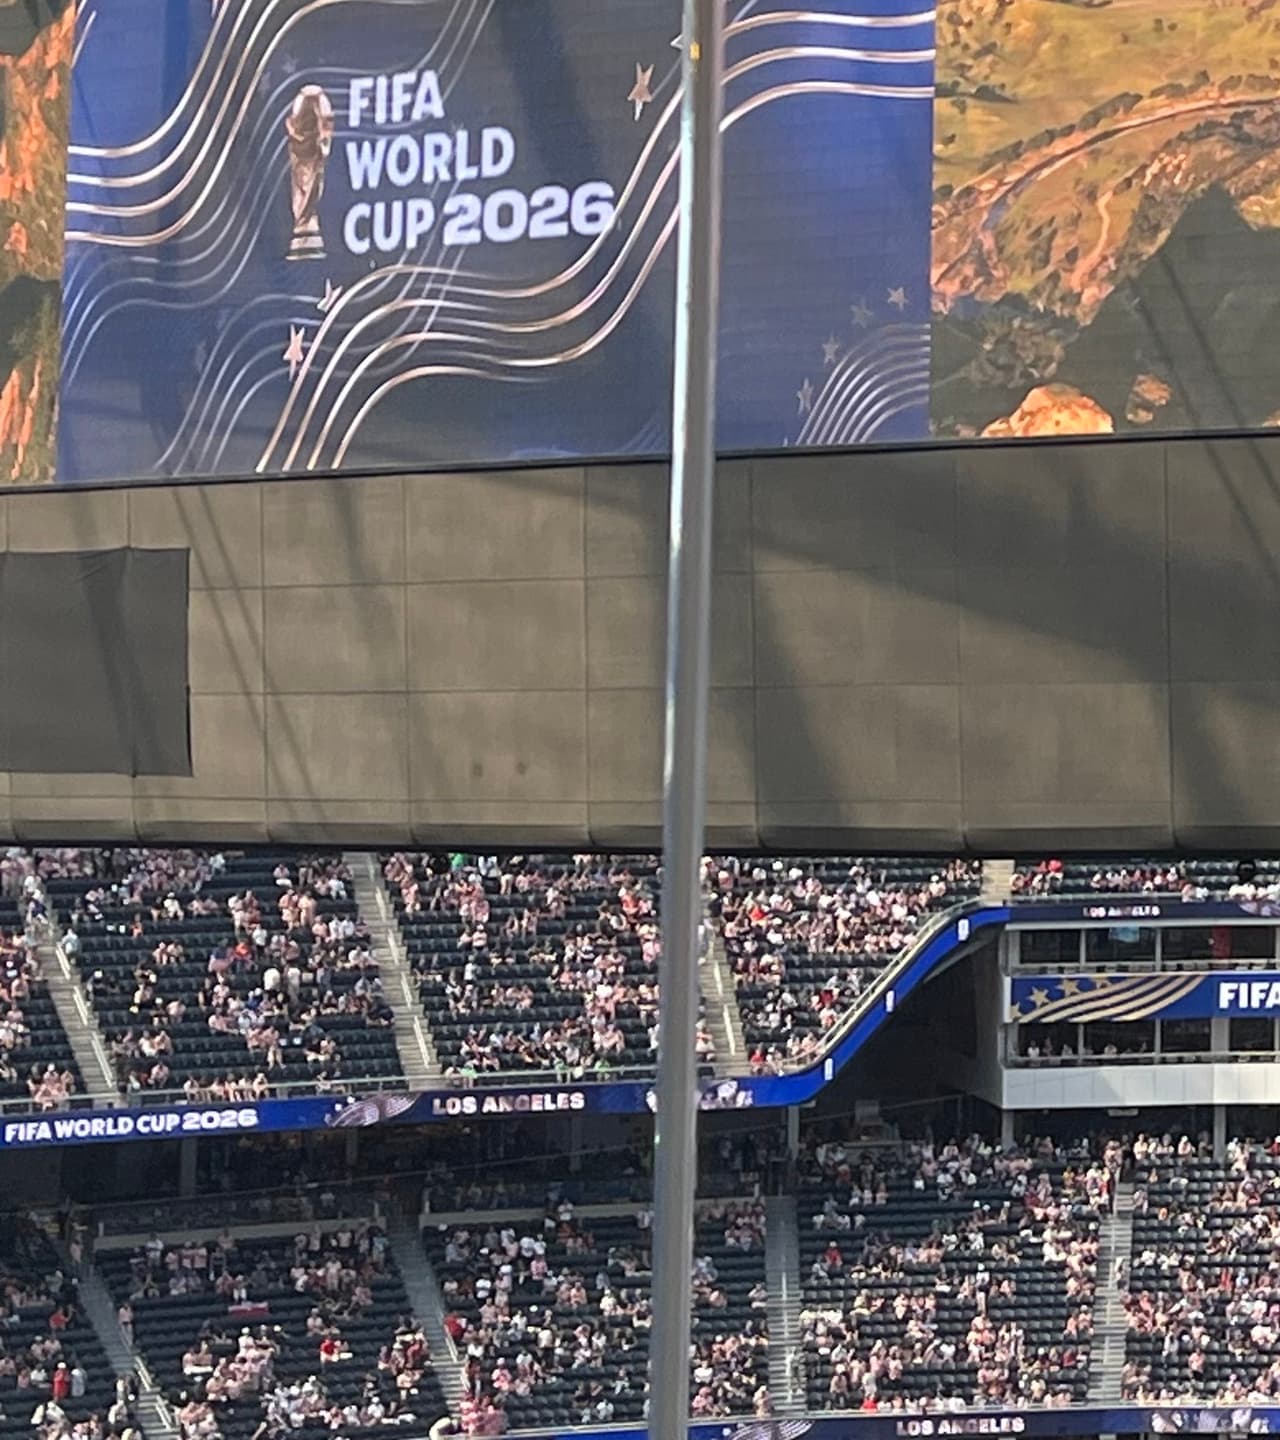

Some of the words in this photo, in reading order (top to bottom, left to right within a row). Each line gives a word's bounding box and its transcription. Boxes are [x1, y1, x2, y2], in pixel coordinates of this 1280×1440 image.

[348, 70, 446, 128] FIFA
[345, 126, 516, 191] WORLD
[343, 197, 435, 255] CUP
[442, 180, 616, 246] 2026
[5, 1123, 51, 1143] FIFA
[54, 1117, 133, 1138] WORLD
[136, 1113, 180, 1133] CUP
[182, 1109, 259, 1130] 2026
[433, 1096, 477, 1115] LOS
[482, 1092, 584, 1112] ANGELES
[897, 1420, 935, 1436] LOS
